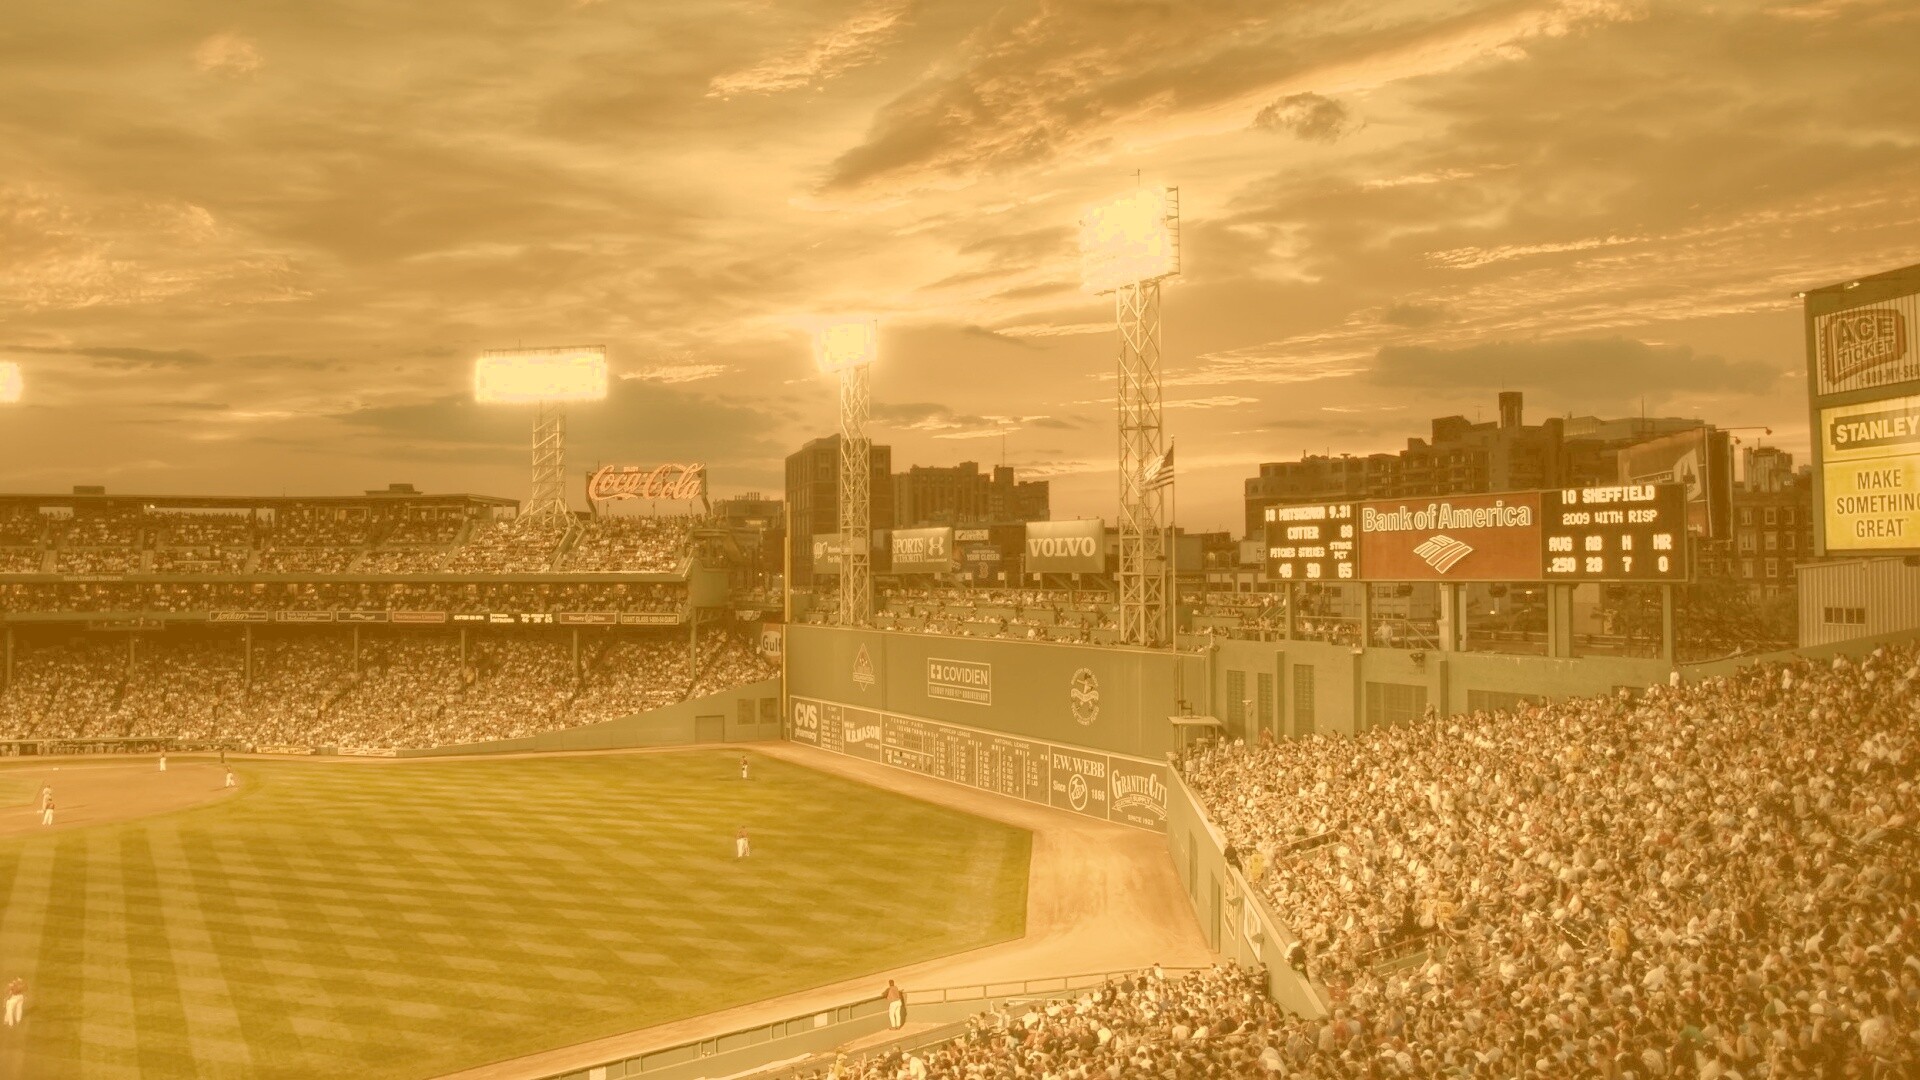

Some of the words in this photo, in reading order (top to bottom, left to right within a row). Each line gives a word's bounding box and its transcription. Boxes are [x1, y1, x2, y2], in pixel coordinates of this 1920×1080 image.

[1837, 316, 1895, 349] ACE
[1839, 341, 1894, 368] TICKET
[1836, 414, 1919, 444] STANLEY
[589, 463, 704, 500] Coca-Cola
[1857, 469, 1902, 490] MAKE
[1562, 489, 1577, 504] 10
[1582, 485, 1655, 504] SHEFFIELD
[1329, 505, 1351, 518] 9.31
[1362, 505, 1413, 532] Bank
[1414, 503, 1437, 530] of
[1438, 500, 1531, 530] America
[1562, 512, 1590, 525] 2009
[1594, 511, 1624, 524] WITH
[1628, 509, 1658, 523] RISP
[1287, 526, 1319, 540] CUTTER
[1548, 536, 1573, 551] AVG
[1621, 535, 1632, 550] H
[1653, 534, 1672, 550] HR
[893, 538, 923, 554] SPORTS
[1028, 536, 1096, 557] VOLVO
[1547, 557, 1576, 572] .250
[1622, 556, 1632, 572] 7
[1658, 556, 1669, 572] 0
[943, 666, 988, 685] COVIDIEN
[795, 702, 817, 730] CVS
[1072, 757, 1105, 778] WEBB
